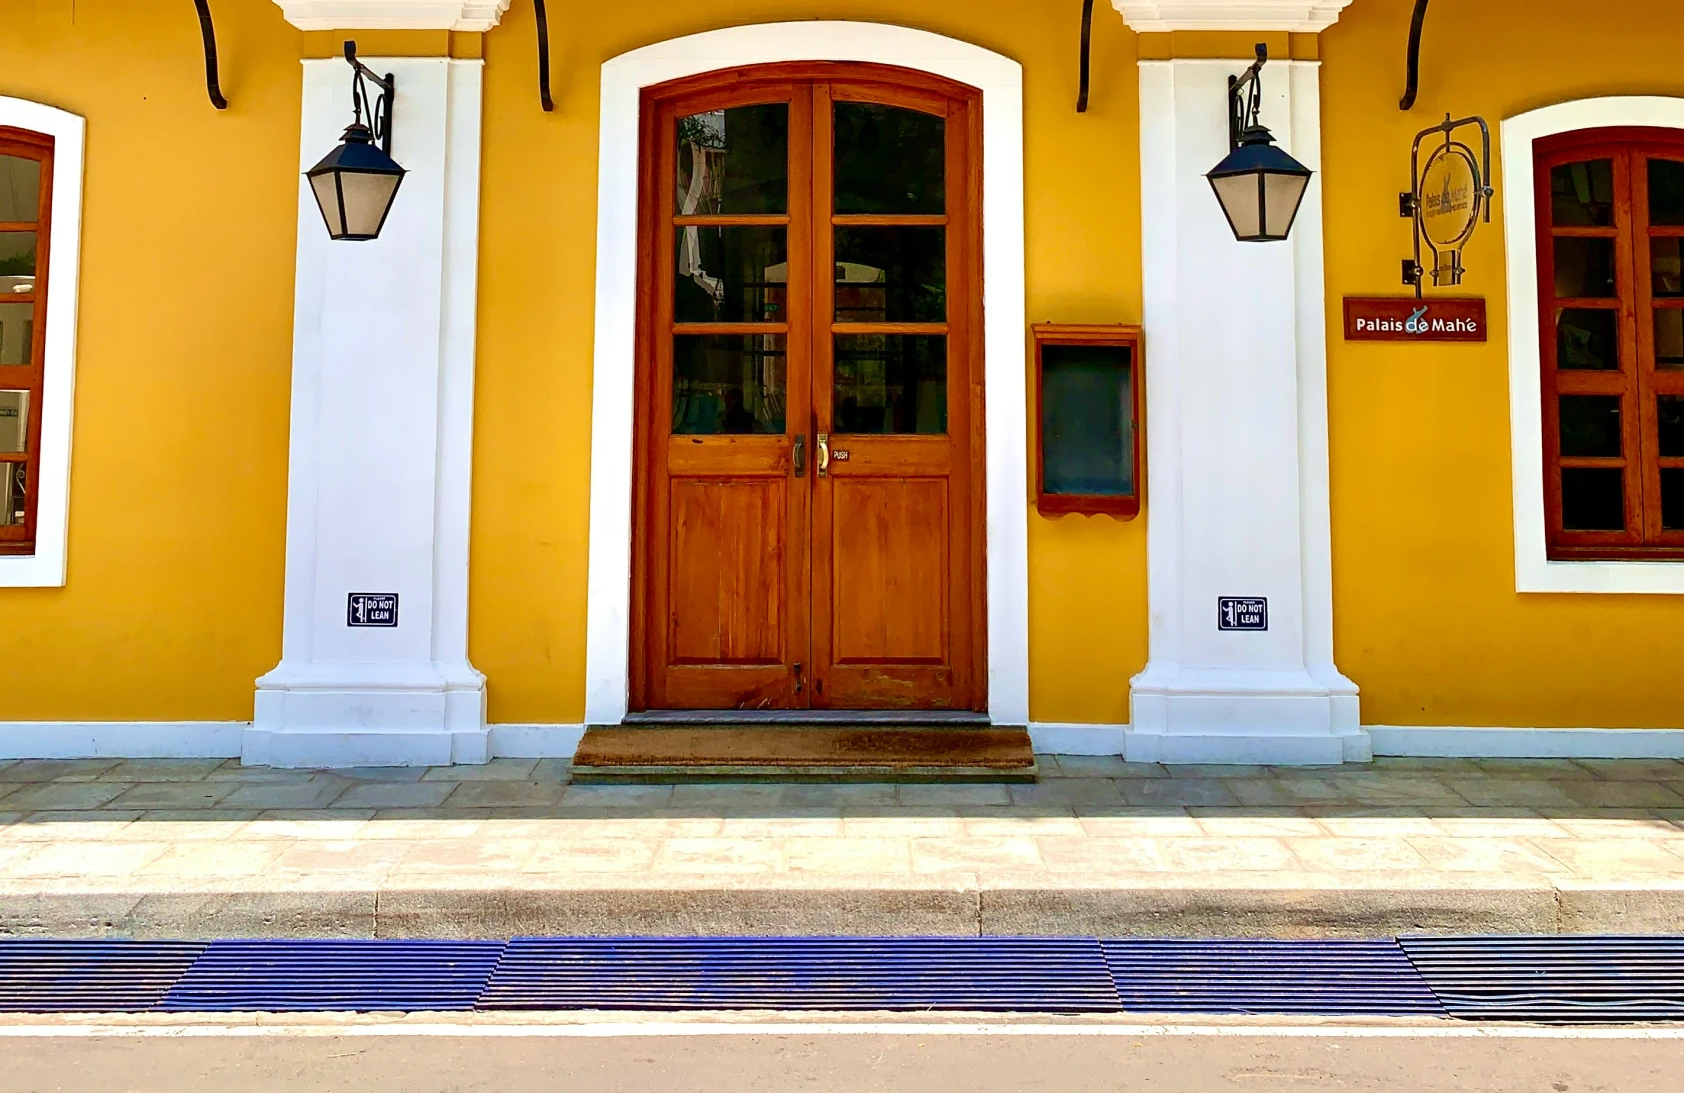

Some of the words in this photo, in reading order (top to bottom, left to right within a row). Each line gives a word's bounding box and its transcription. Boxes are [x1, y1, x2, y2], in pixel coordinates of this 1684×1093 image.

[1356, 317, 1403, 331] Palais
[1431, 317, 1477, 332] Mahé
[833, 451, 848, 459] PUSH
[367, 600, 378, 609] DO
[379, 600, 393, 609] NOT
[1237, 604, 1247, 613] DO
[1248, 604, 1263, 613] NOT
[371, 611, 389, 619] LEAN
[1241, 614, 1260, 623] LEAN
